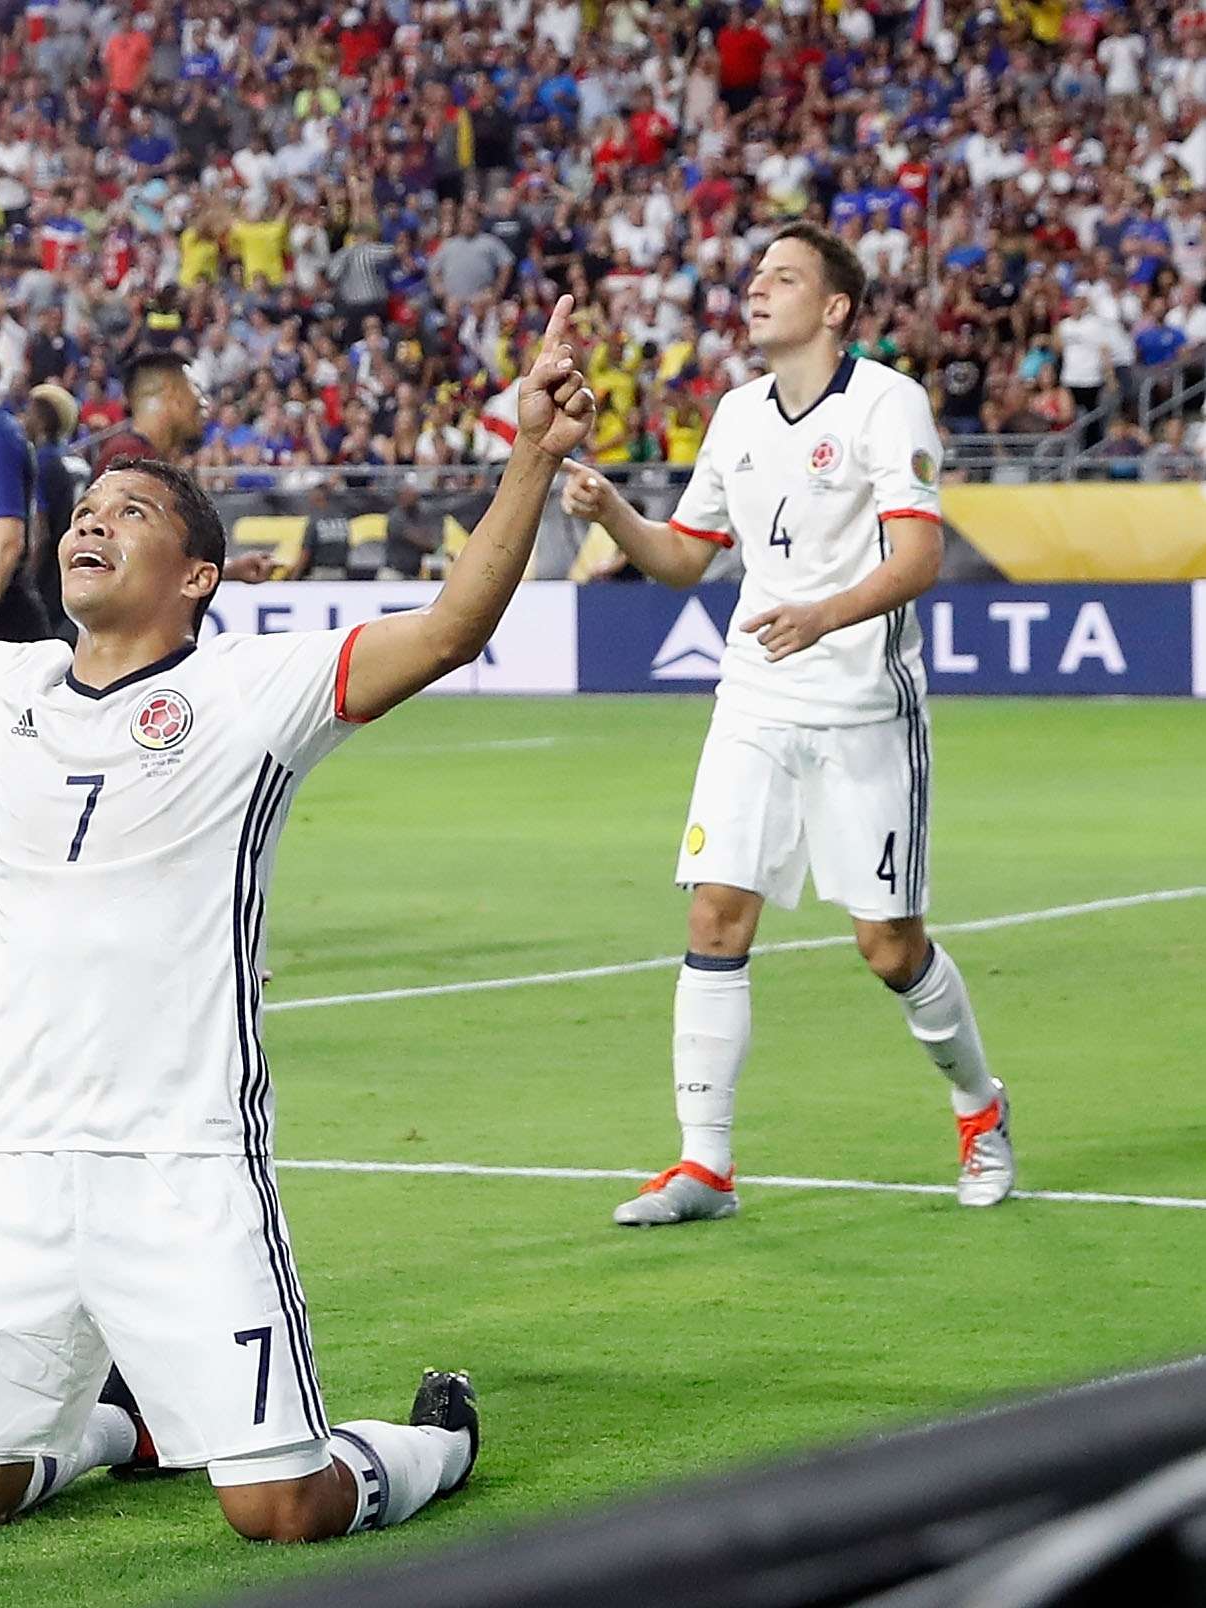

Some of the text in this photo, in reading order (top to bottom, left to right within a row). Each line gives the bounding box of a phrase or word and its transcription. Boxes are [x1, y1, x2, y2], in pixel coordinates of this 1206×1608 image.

[768, 496, 792, 559] 4
[932, 601, 1127, 674] LTA
[66, 774, 105, 862] 7
[876, 830, 896, 895] 4
[234, 1326, 272, 1426] 7
